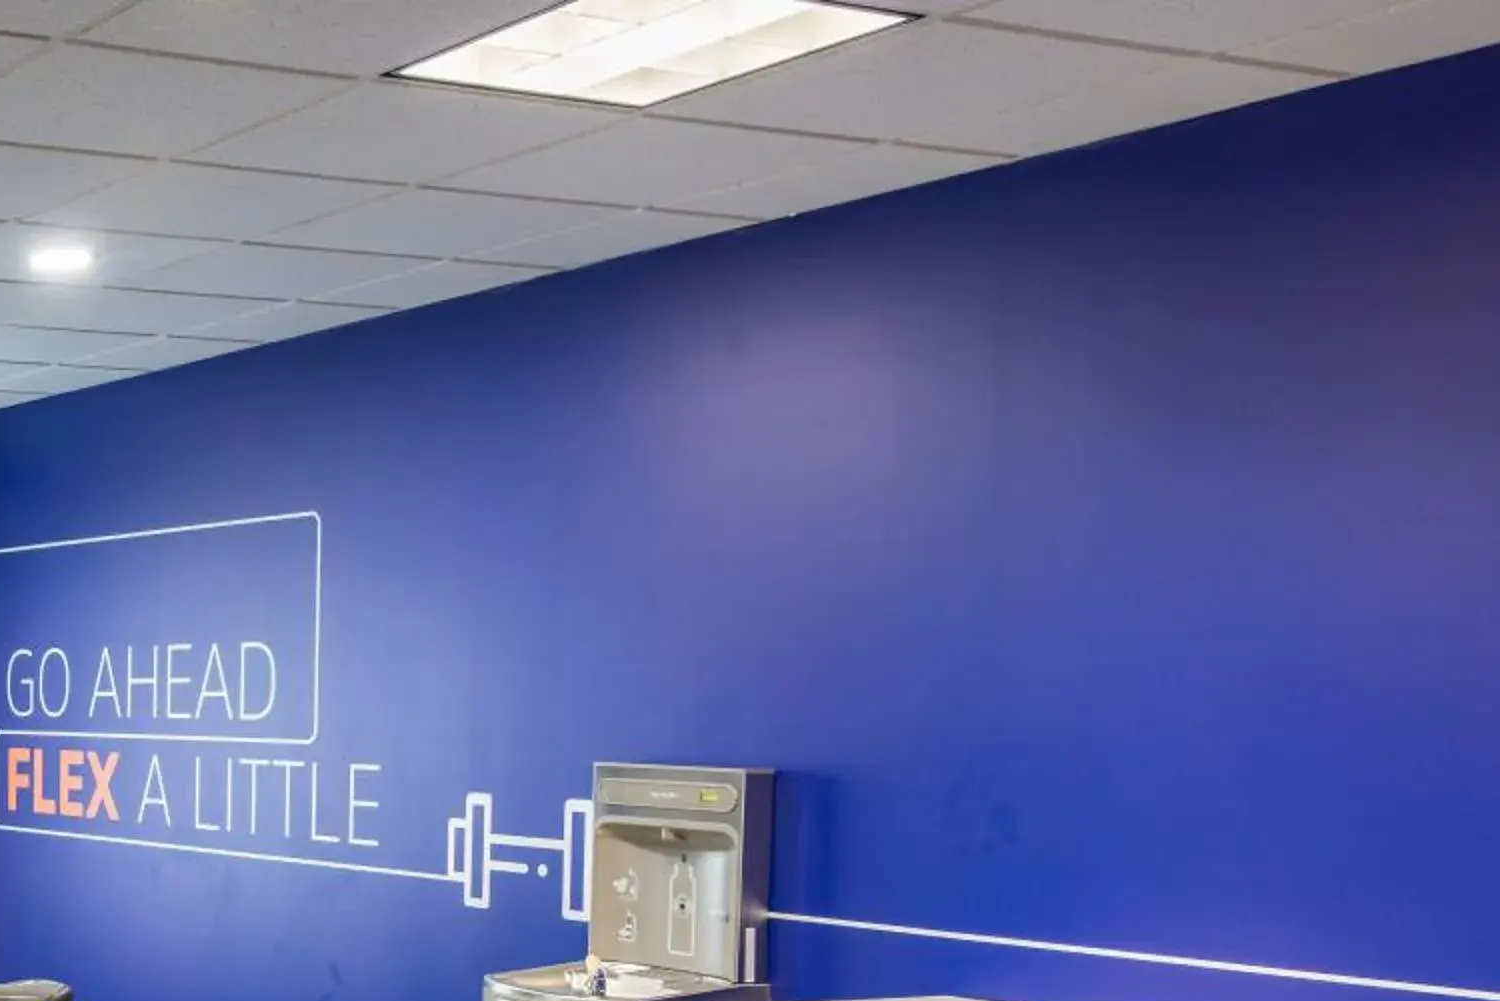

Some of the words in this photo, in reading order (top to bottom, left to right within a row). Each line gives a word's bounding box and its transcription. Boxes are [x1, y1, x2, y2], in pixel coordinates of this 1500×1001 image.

[6, 647, 71, 718] GO
[88, 641, 277, 722] AHEAD
[6, 747, 120, 822] FLEX
[137, 753, 171, 828] A
[195, 756, 381, 847] LITTLE
